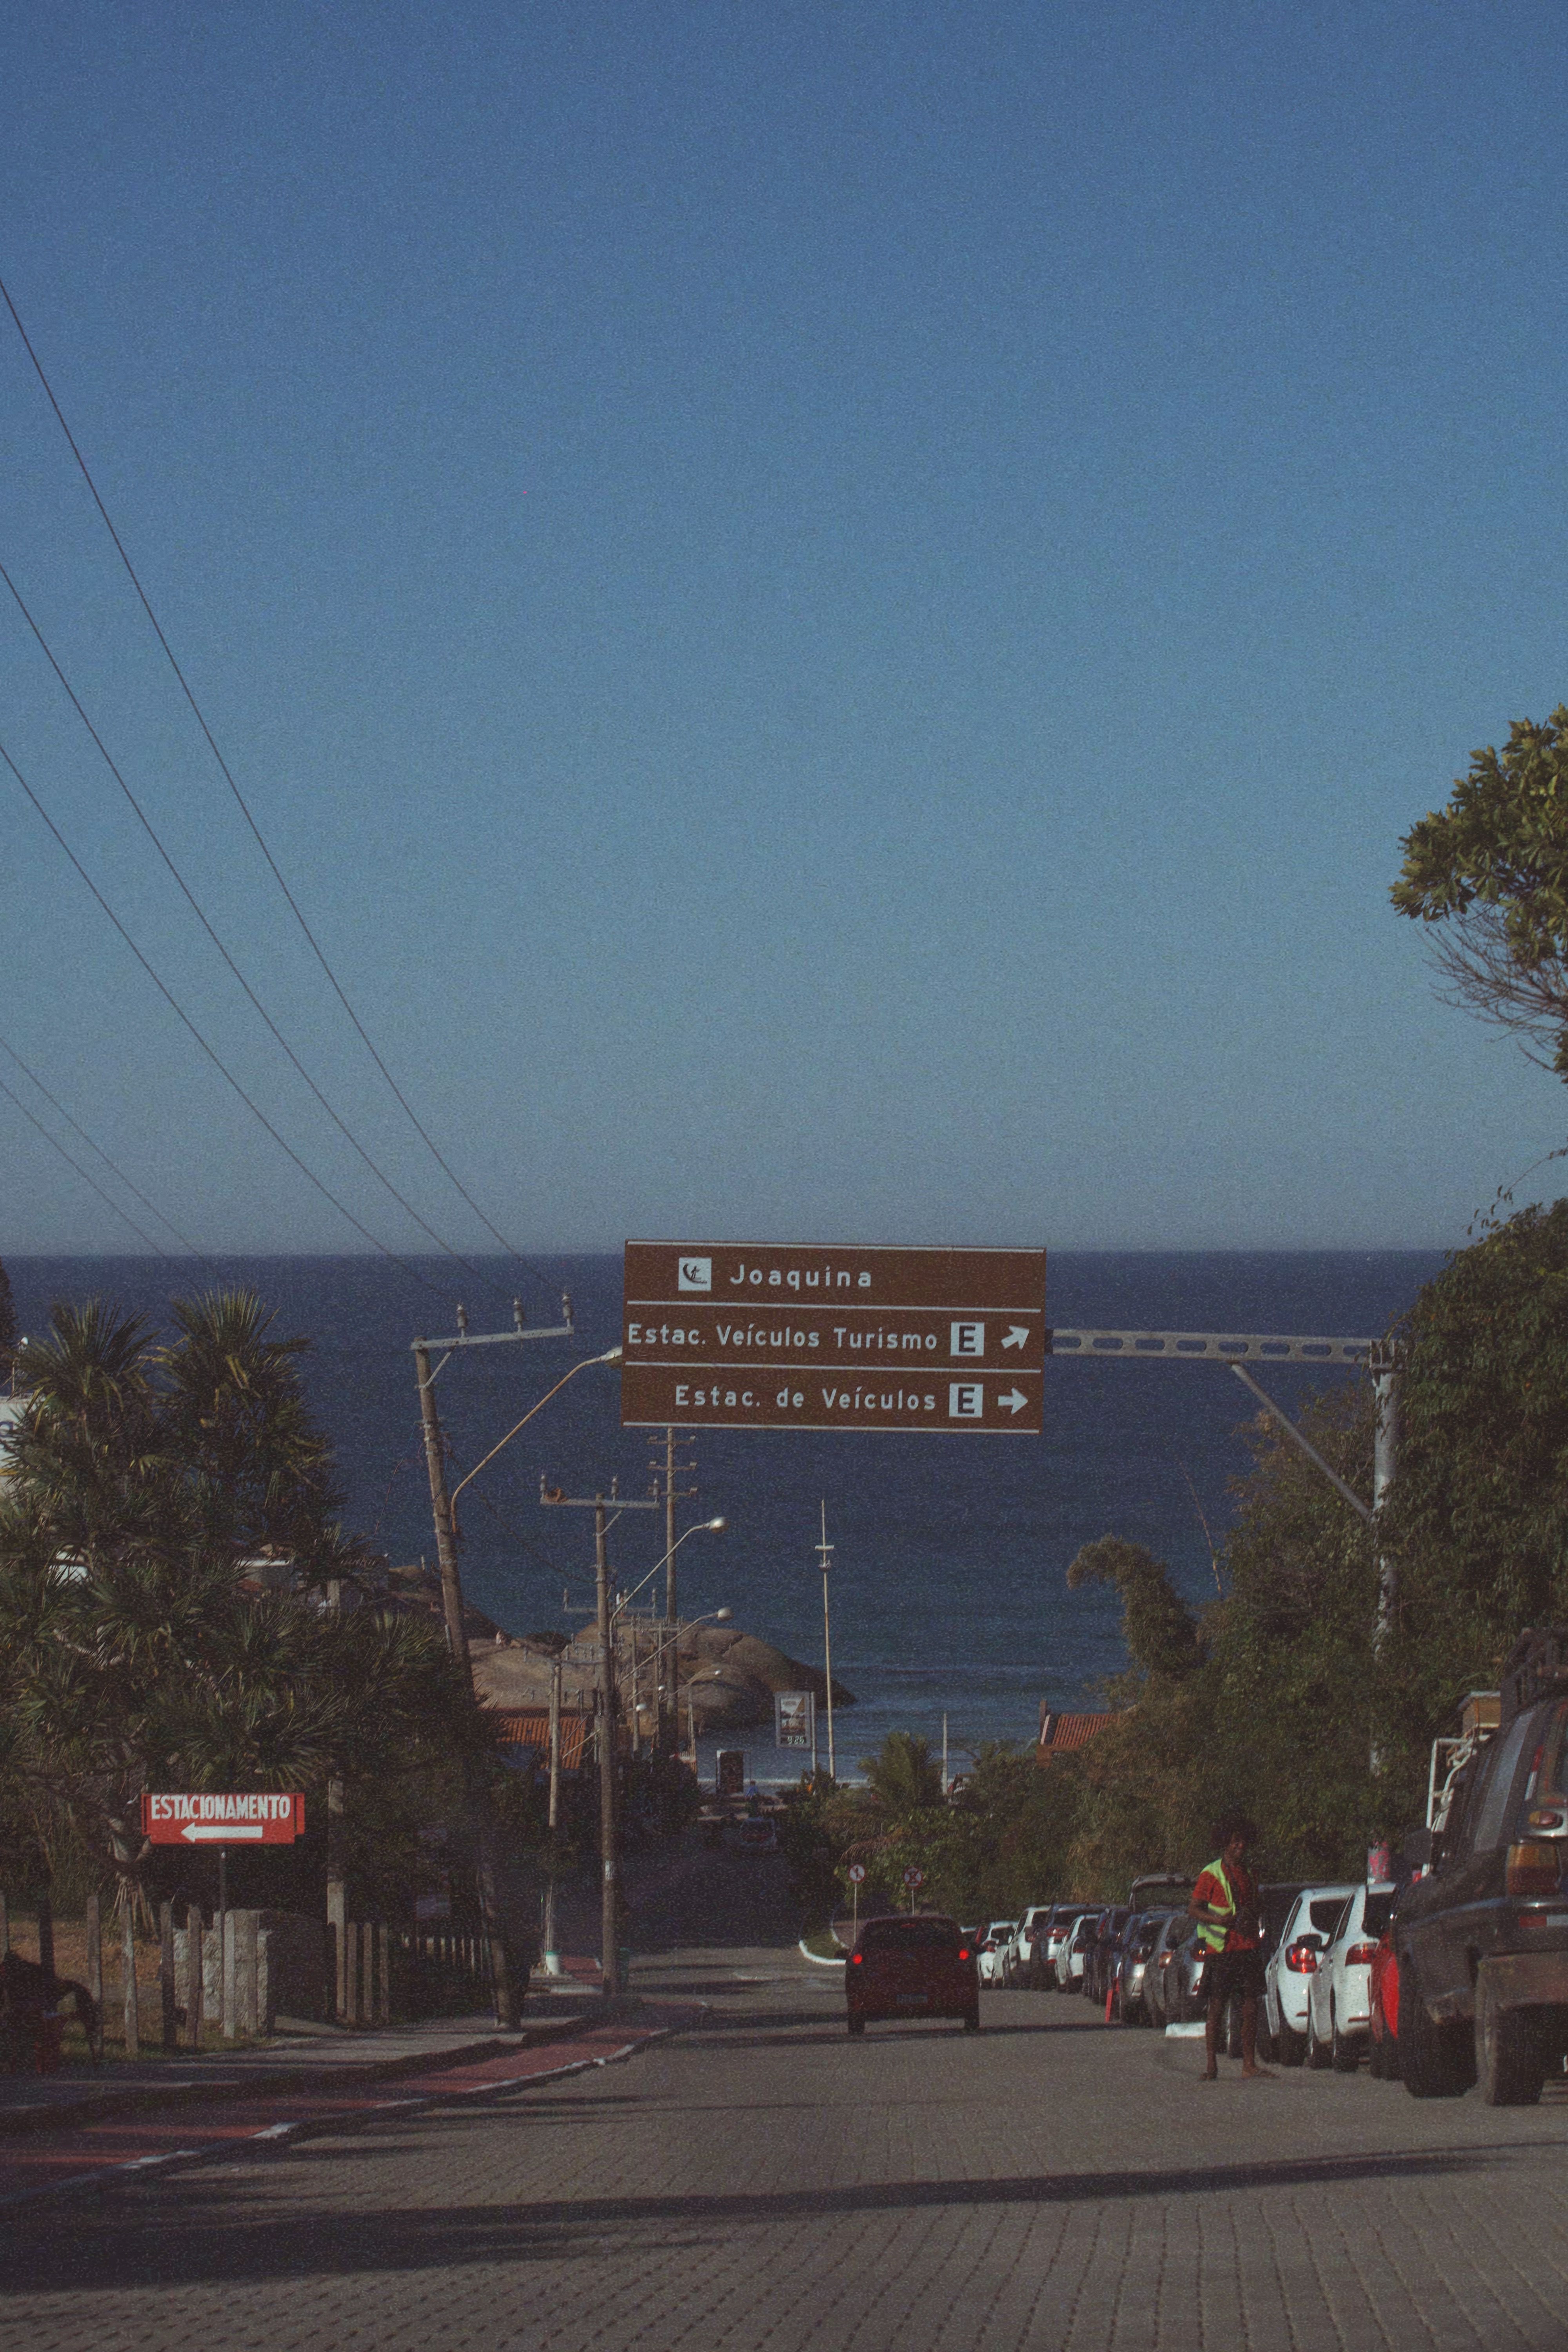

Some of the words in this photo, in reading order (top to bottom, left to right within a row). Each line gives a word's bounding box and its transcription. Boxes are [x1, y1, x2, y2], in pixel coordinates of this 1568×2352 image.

[730, 1264, 871, 1291] Joaquina
[628, 1323, 706, 1346] Estac.
[716, 1323, 820, 1348] Veículos
[833, 1327, 938, 1350] Turismo
[958, 1325, 976, 1353] E
[675, 1384, 760, 1407] Estac.
[776, 1387, 804, 1408] de
[822, 1386, 936, 1410] Veículos
[957, 1386, 976, 1415] E
[151, 1794, 291, 1820] ESTACIONAMENTO
